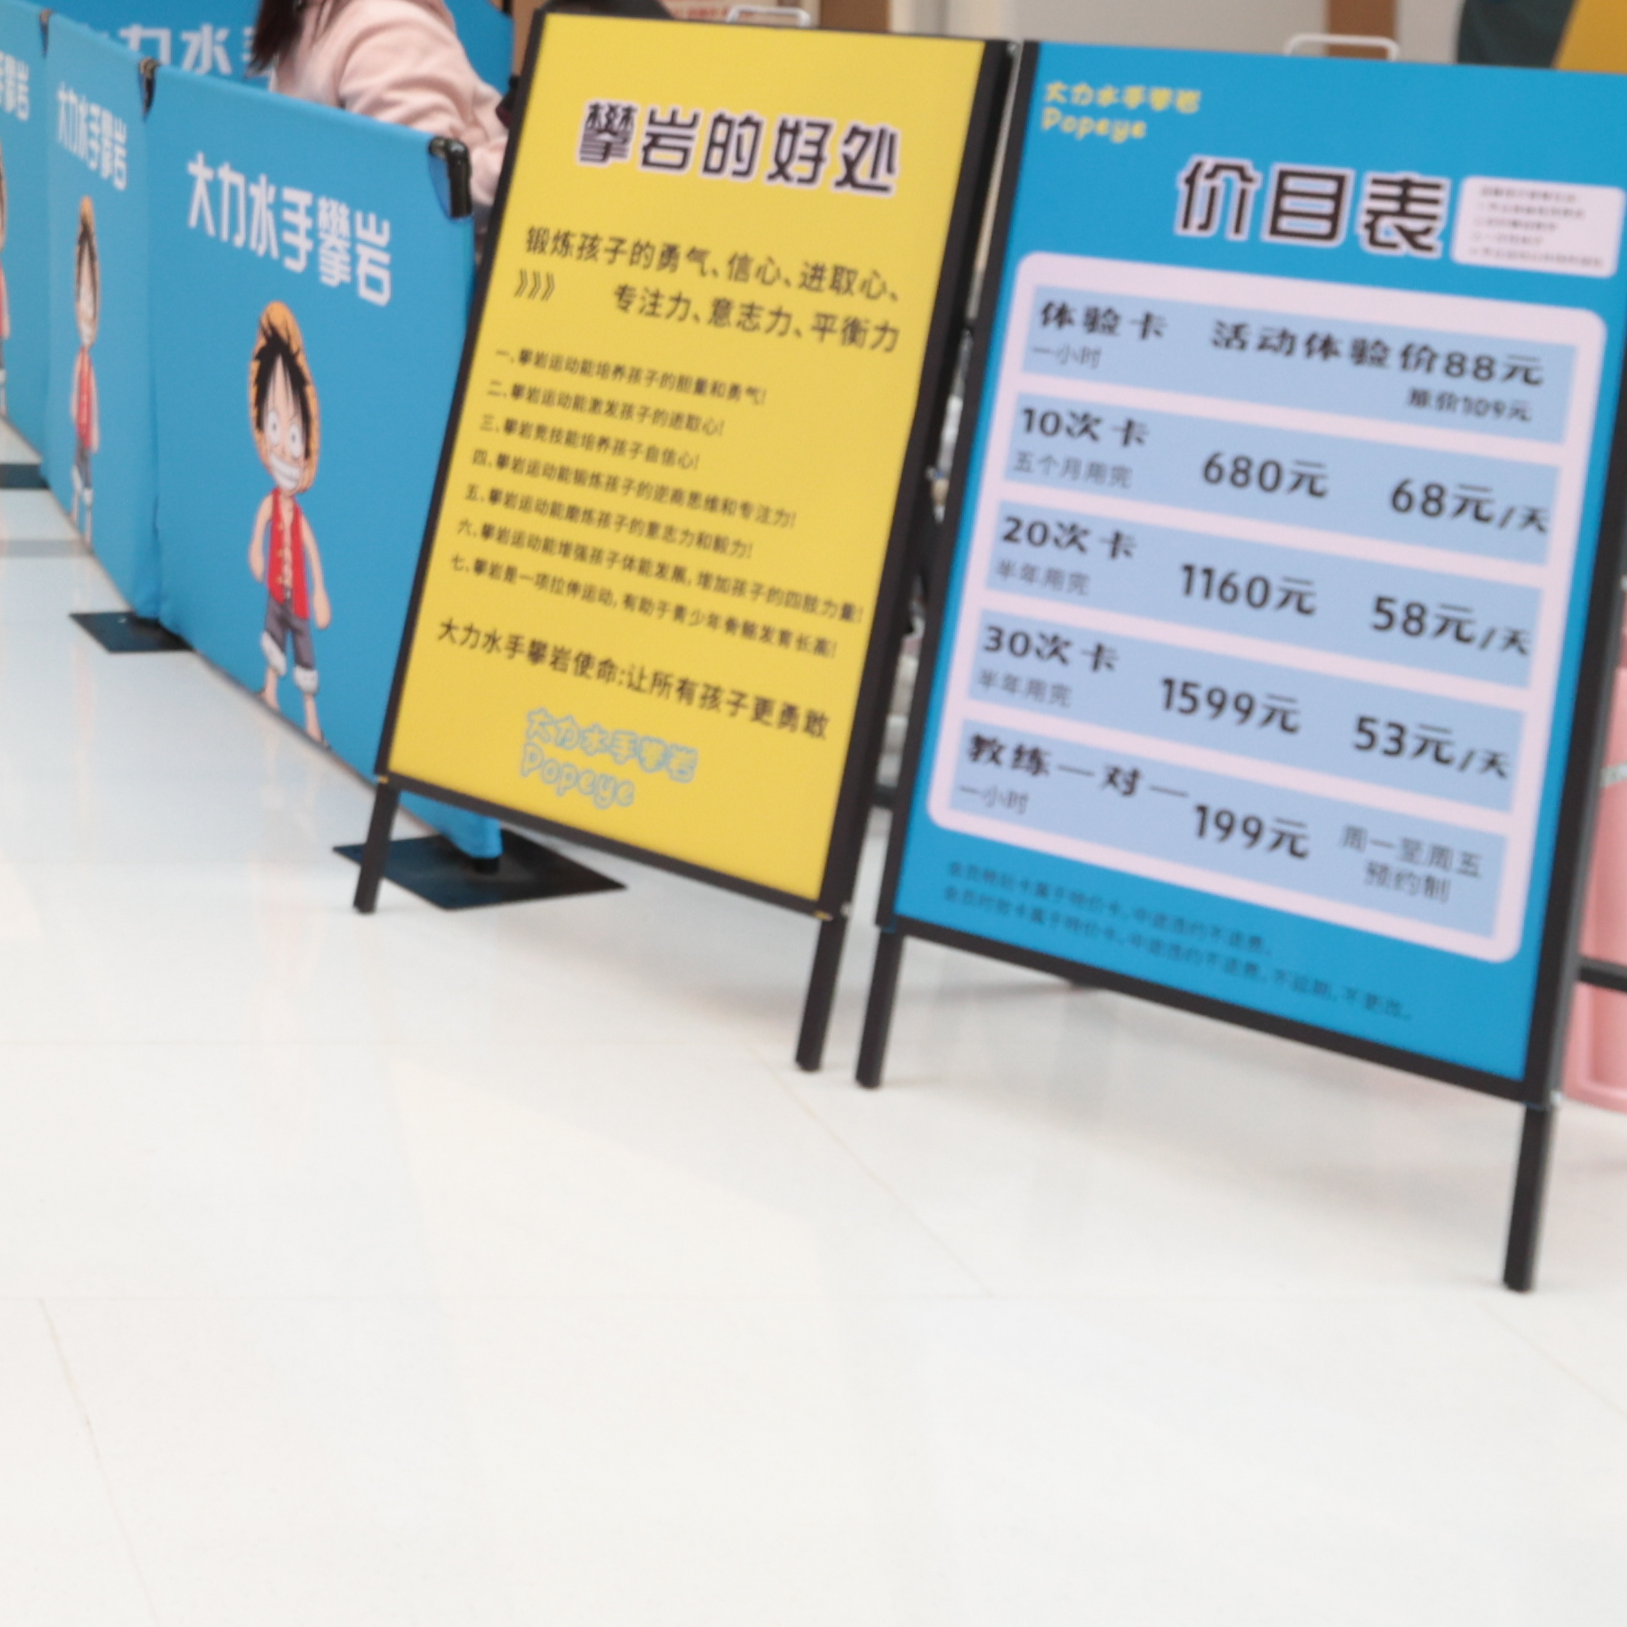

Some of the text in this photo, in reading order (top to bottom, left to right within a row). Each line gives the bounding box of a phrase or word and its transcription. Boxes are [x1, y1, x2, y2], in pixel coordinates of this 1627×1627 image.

[56, 81, 129, 192] 大力水手攀岩
[576, 99, 903, 198] 攀岩的好处
[1040, 108, 1149, 143] Popeye
[187, 151, 394, 307] 大力水手攀岩
[1175, 155, 1450, 258] 价目表
[613, 282, 901, 353] 专注力、意志力、平衡力
[1030, 340, 1103, 370] 一小时
[1039, 299, 1546, 387] 体验卡 活动体验价88元
[1018, 404, 1551, 536] 10次卡 680元 68元/天
[996, 559, 1092, 597] 半年用完
[1002, 515, 1532, 658] 20次卡 1160元 58元/天
[976, 668, 1073, 709] 半年用完
[982, 625, 1512, 781] 30次卡 1599元 53元/天
[519, 741, 637, 810] Popeye
[956, 784, 1031, 816] 一小时
[968, 734, 1191, 799] 教练一对一
[1192, 804, 1311, 861] 199元
